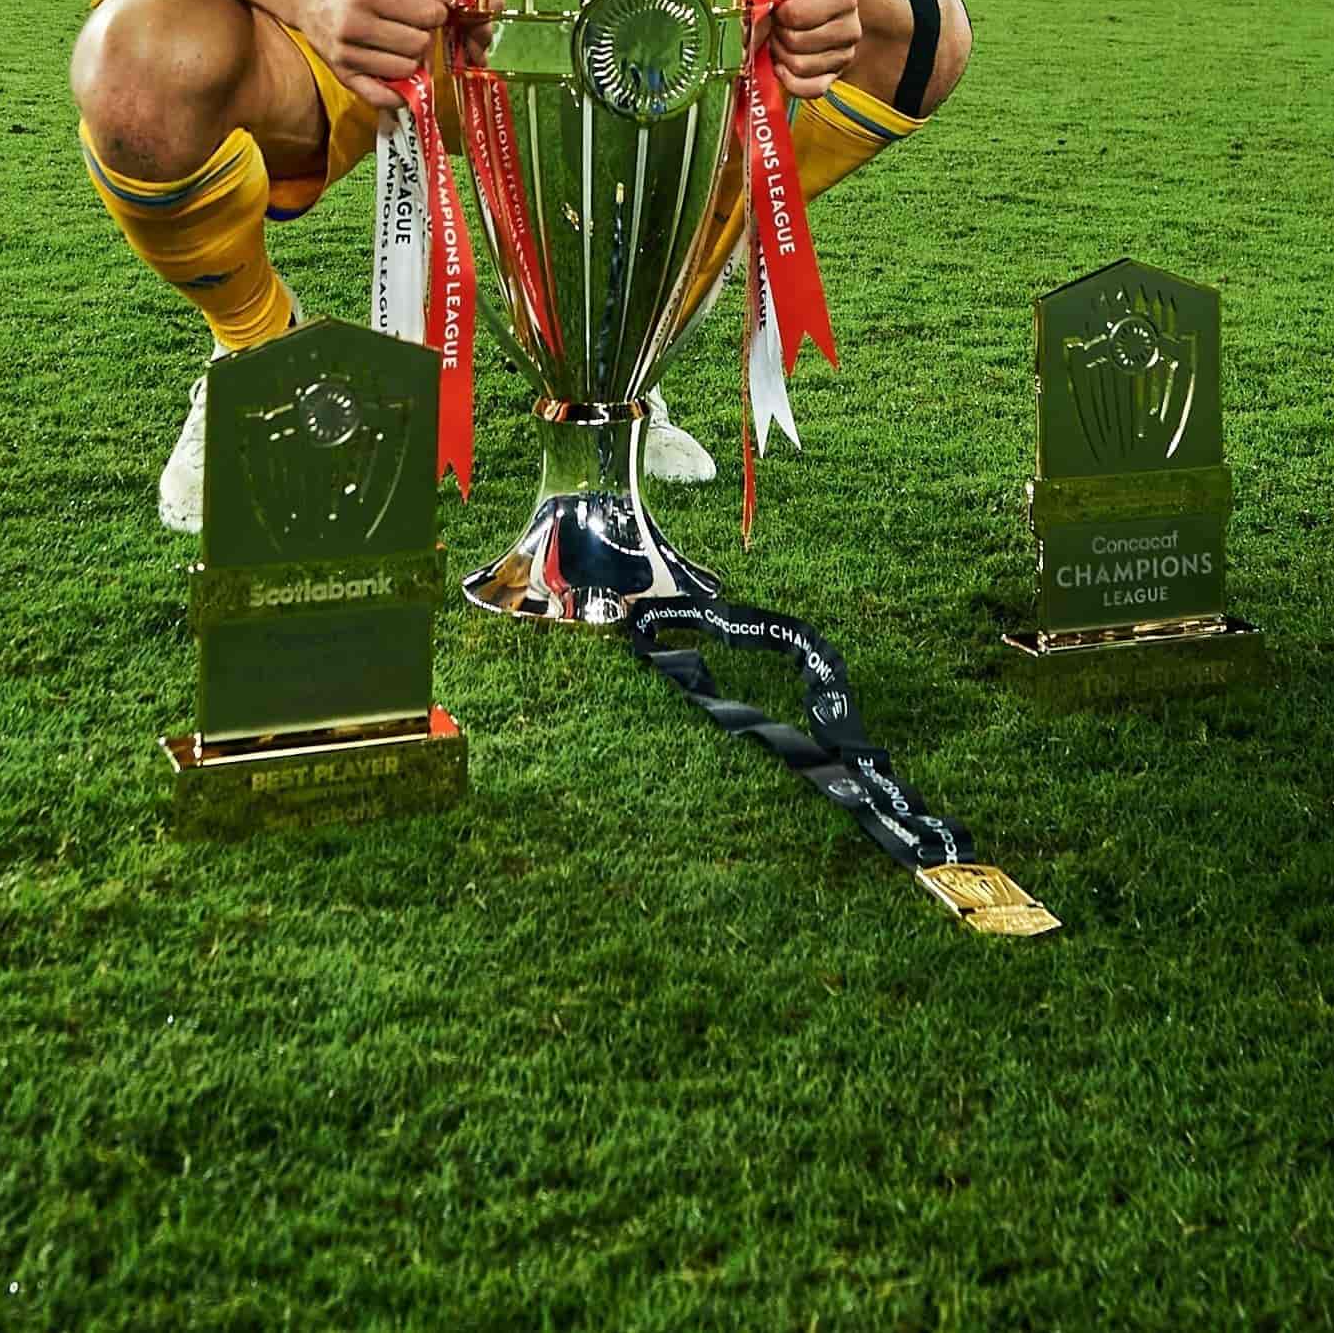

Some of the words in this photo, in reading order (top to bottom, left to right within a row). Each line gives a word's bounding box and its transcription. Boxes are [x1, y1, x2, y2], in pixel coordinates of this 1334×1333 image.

[380, 146, 397, 249] AMPIONS
[749, 86, 780, 169] MPIONS
[767, 174, 796, 256] LEAGUE
[395, 187, 413, 245] AGUE
[435, 139, 461, 276] CHAMPIONS
[378, 255, 389, 332] LEAGU
[442, 281, 461, 370] LEAGUE
[1055, 552, 1213, 588] CHAMPIONS
[1091, 530, 1179, 555] Concacaf
[249, 570, 395, 607] Scotiabank
[1103, 585, 1169, 607] LEAGUE
[251, 766, 308, 792] BEST
[314, 755, 399, 783] PLAYER
